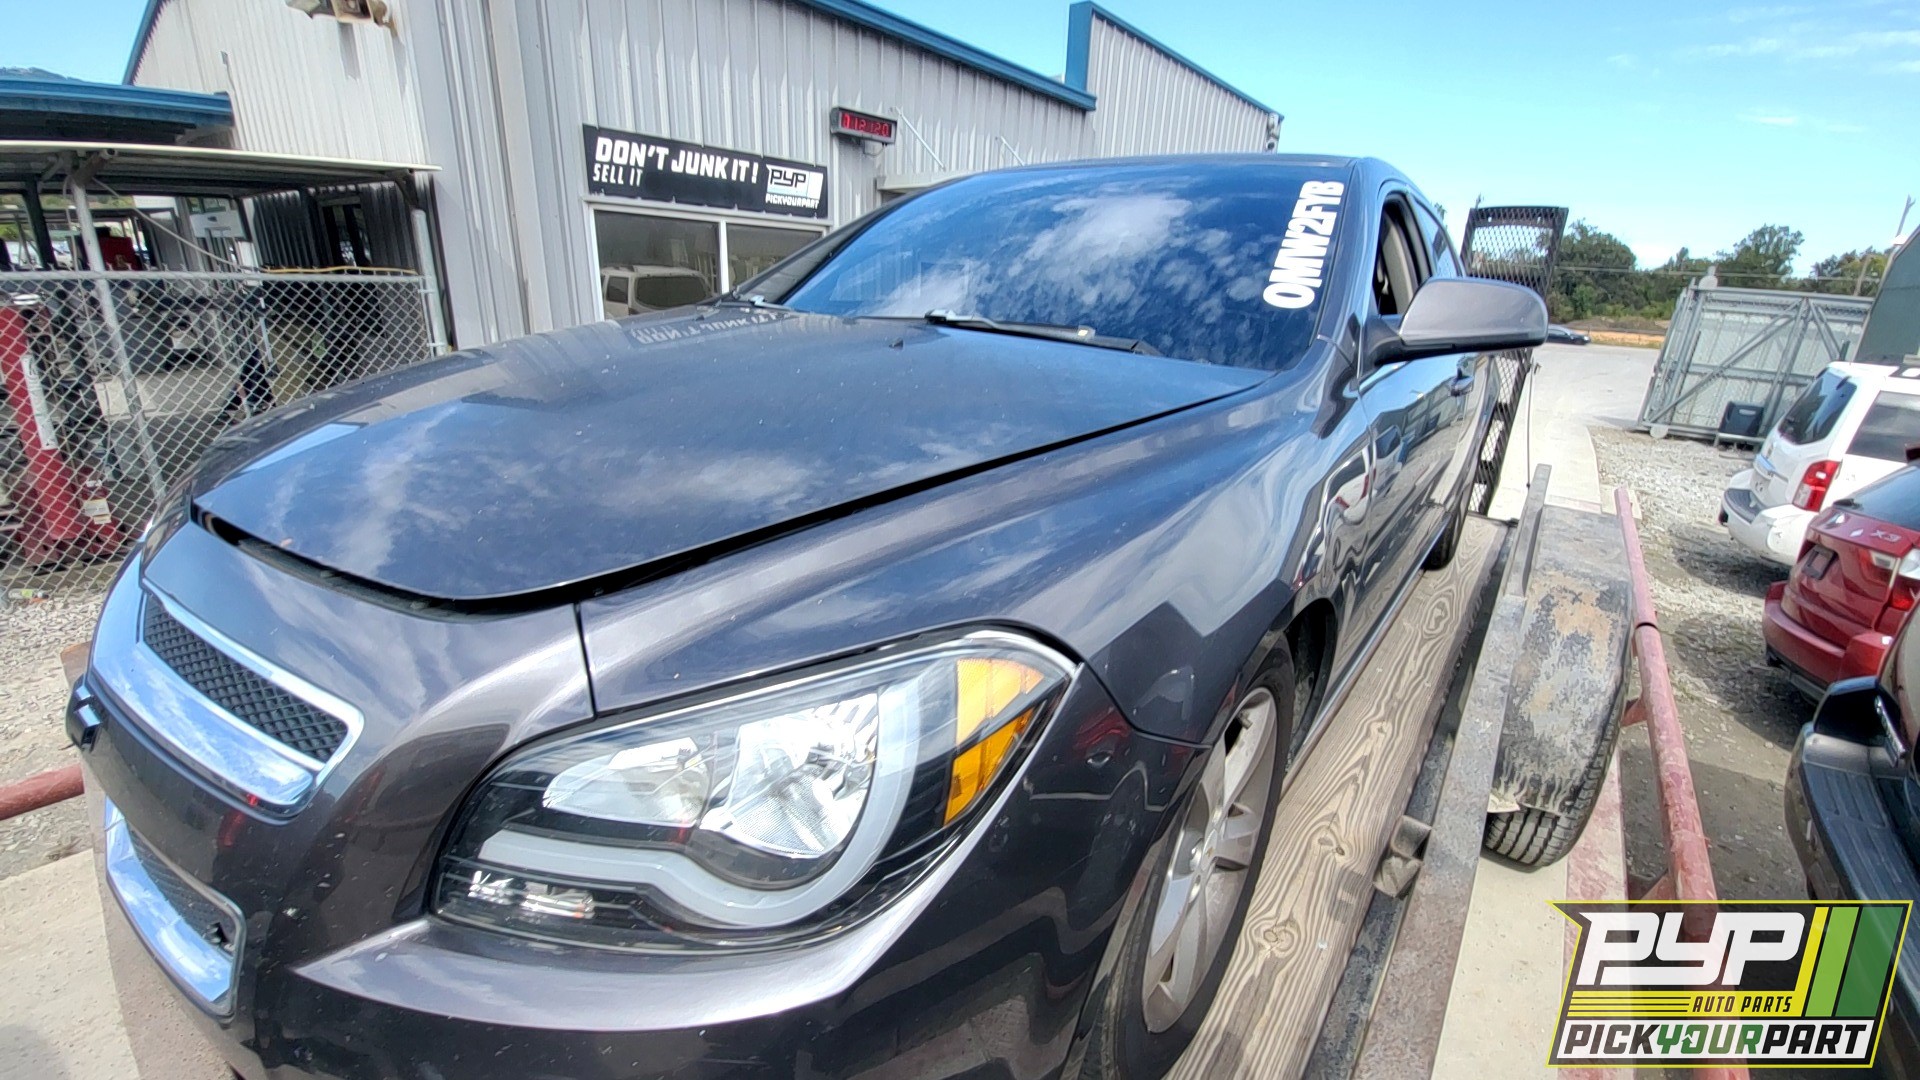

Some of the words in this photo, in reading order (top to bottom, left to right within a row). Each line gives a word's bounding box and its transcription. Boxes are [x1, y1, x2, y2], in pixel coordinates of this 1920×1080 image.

[592, 163, 624, 185] SELL
[629, 167, 643, 187] IT
[595, 136, 669, 171] DON'T
[671, 150, 729, 180] JUNK
[1263, 181, 1344, 309] OMW2FYB
[1870, 529, 1902, 542] X3
